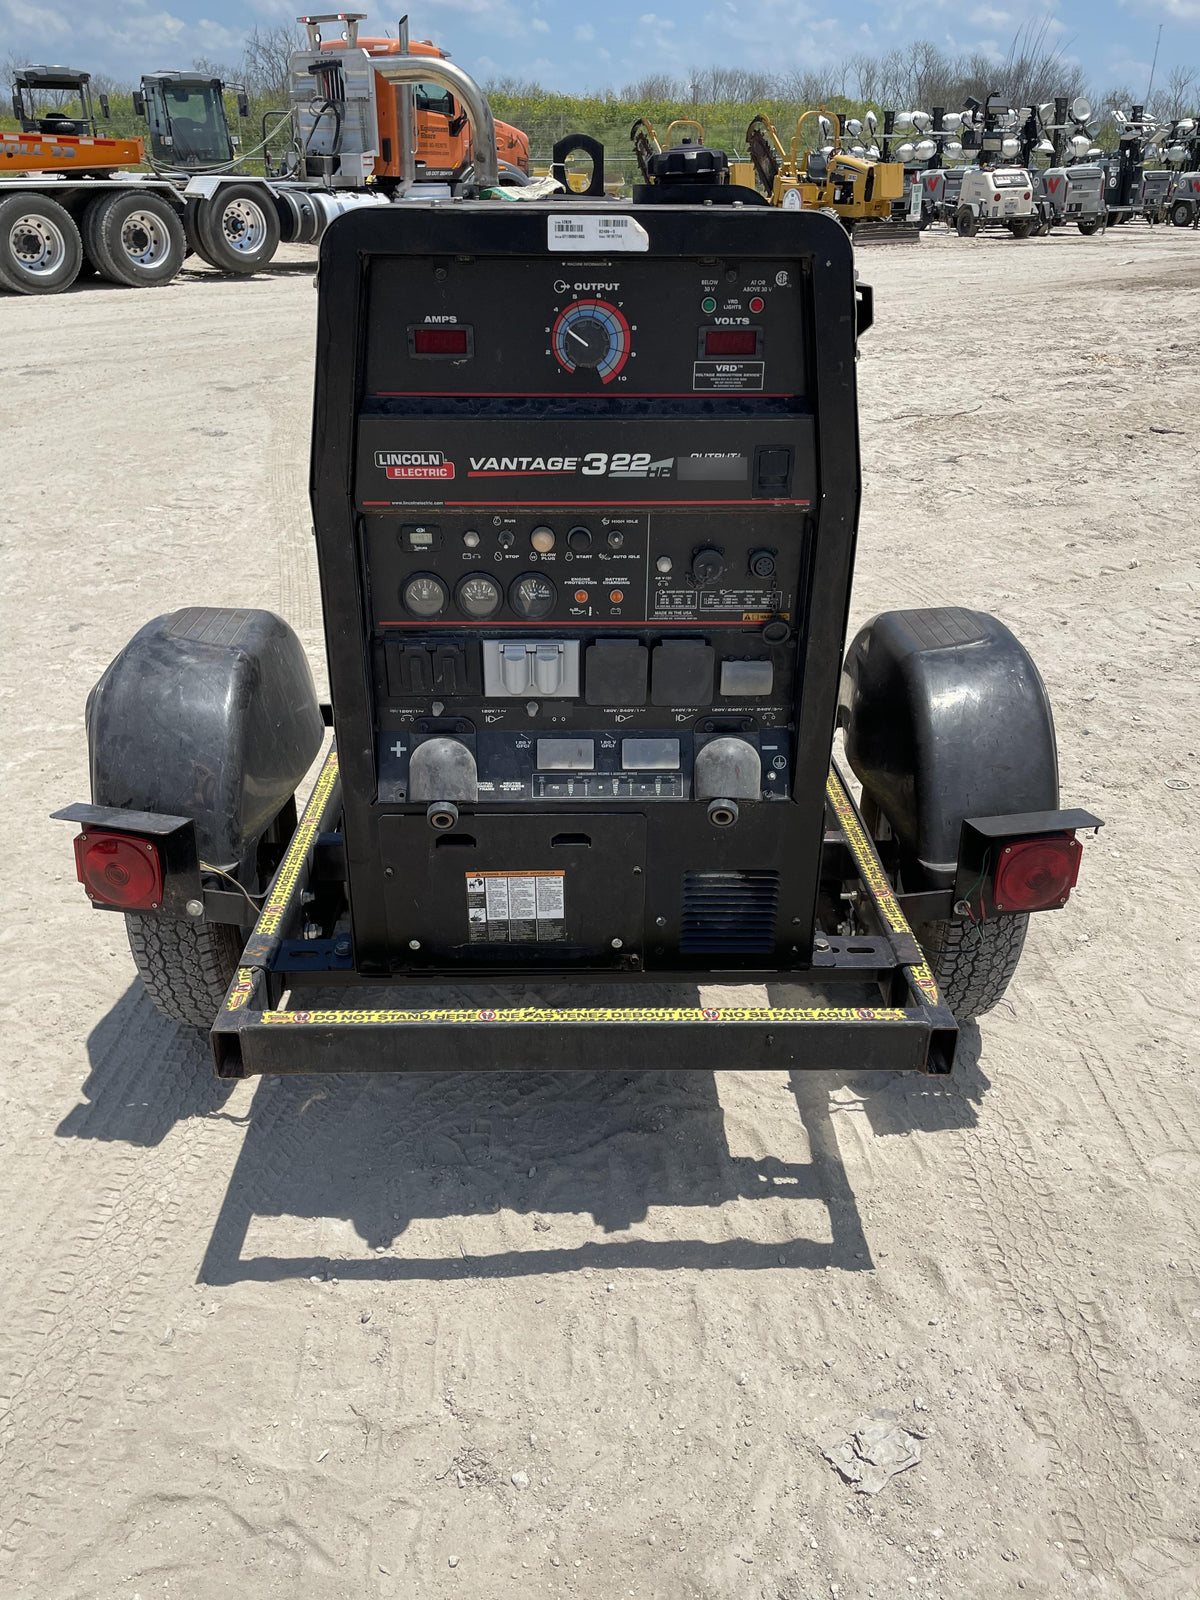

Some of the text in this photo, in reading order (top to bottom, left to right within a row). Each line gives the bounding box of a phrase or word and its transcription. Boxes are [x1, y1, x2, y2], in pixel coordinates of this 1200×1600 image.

[379, 454, 440, 466] LINCOLN
[582, 453, 651, 476] 322
[395, 469, 448, 477] ELECTRIC
[289, 845, 303, 865] TENEZ
[277, 866, 294, 893] DEBOUT
[264, 914, 275, 925] NO
[378, 1012, 431, 1020] STAND
[434, 1012, 477, 1020] HERE
[499, 1011, 520, 1019] NE
[523, 1010, 554, 1019] PAS
[560, 1011, 608, 1019] TENEZ
[817, 1009, 854, 1018] AQUÍ
